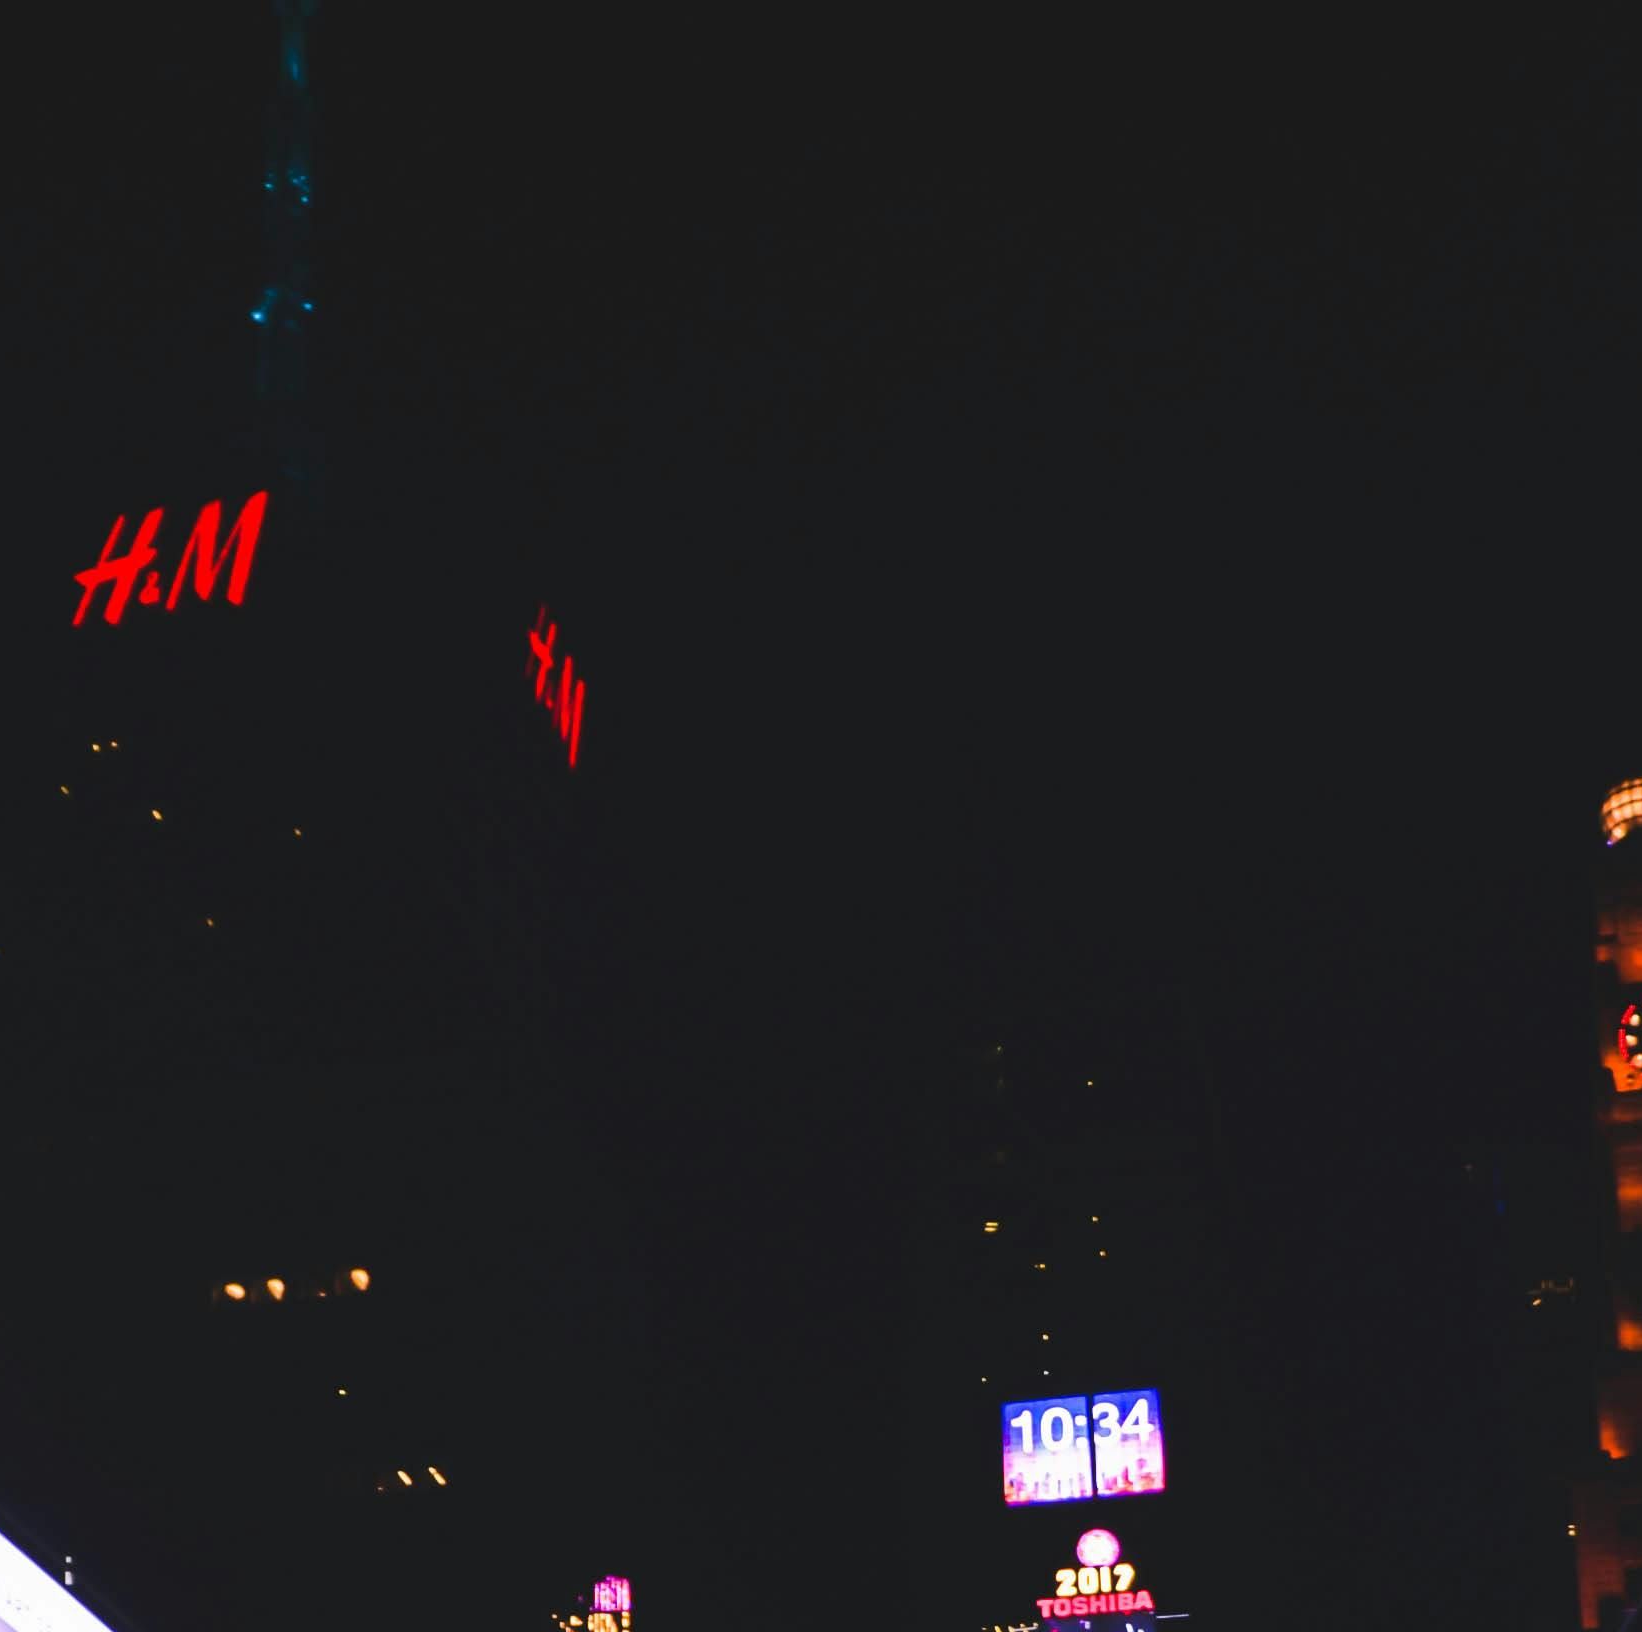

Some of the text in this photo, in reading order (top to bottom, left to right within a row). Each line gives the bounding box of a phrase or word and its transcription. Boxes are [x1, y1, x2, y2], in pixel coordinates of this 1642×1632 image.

[72, 490, 268, 627] H&M
[1010, 1398, 1155, 1454] 10:34
[1055, 1562, 1136, 1598] 2017
[1036, 1589, 1155, 1619] TOSHIBA
